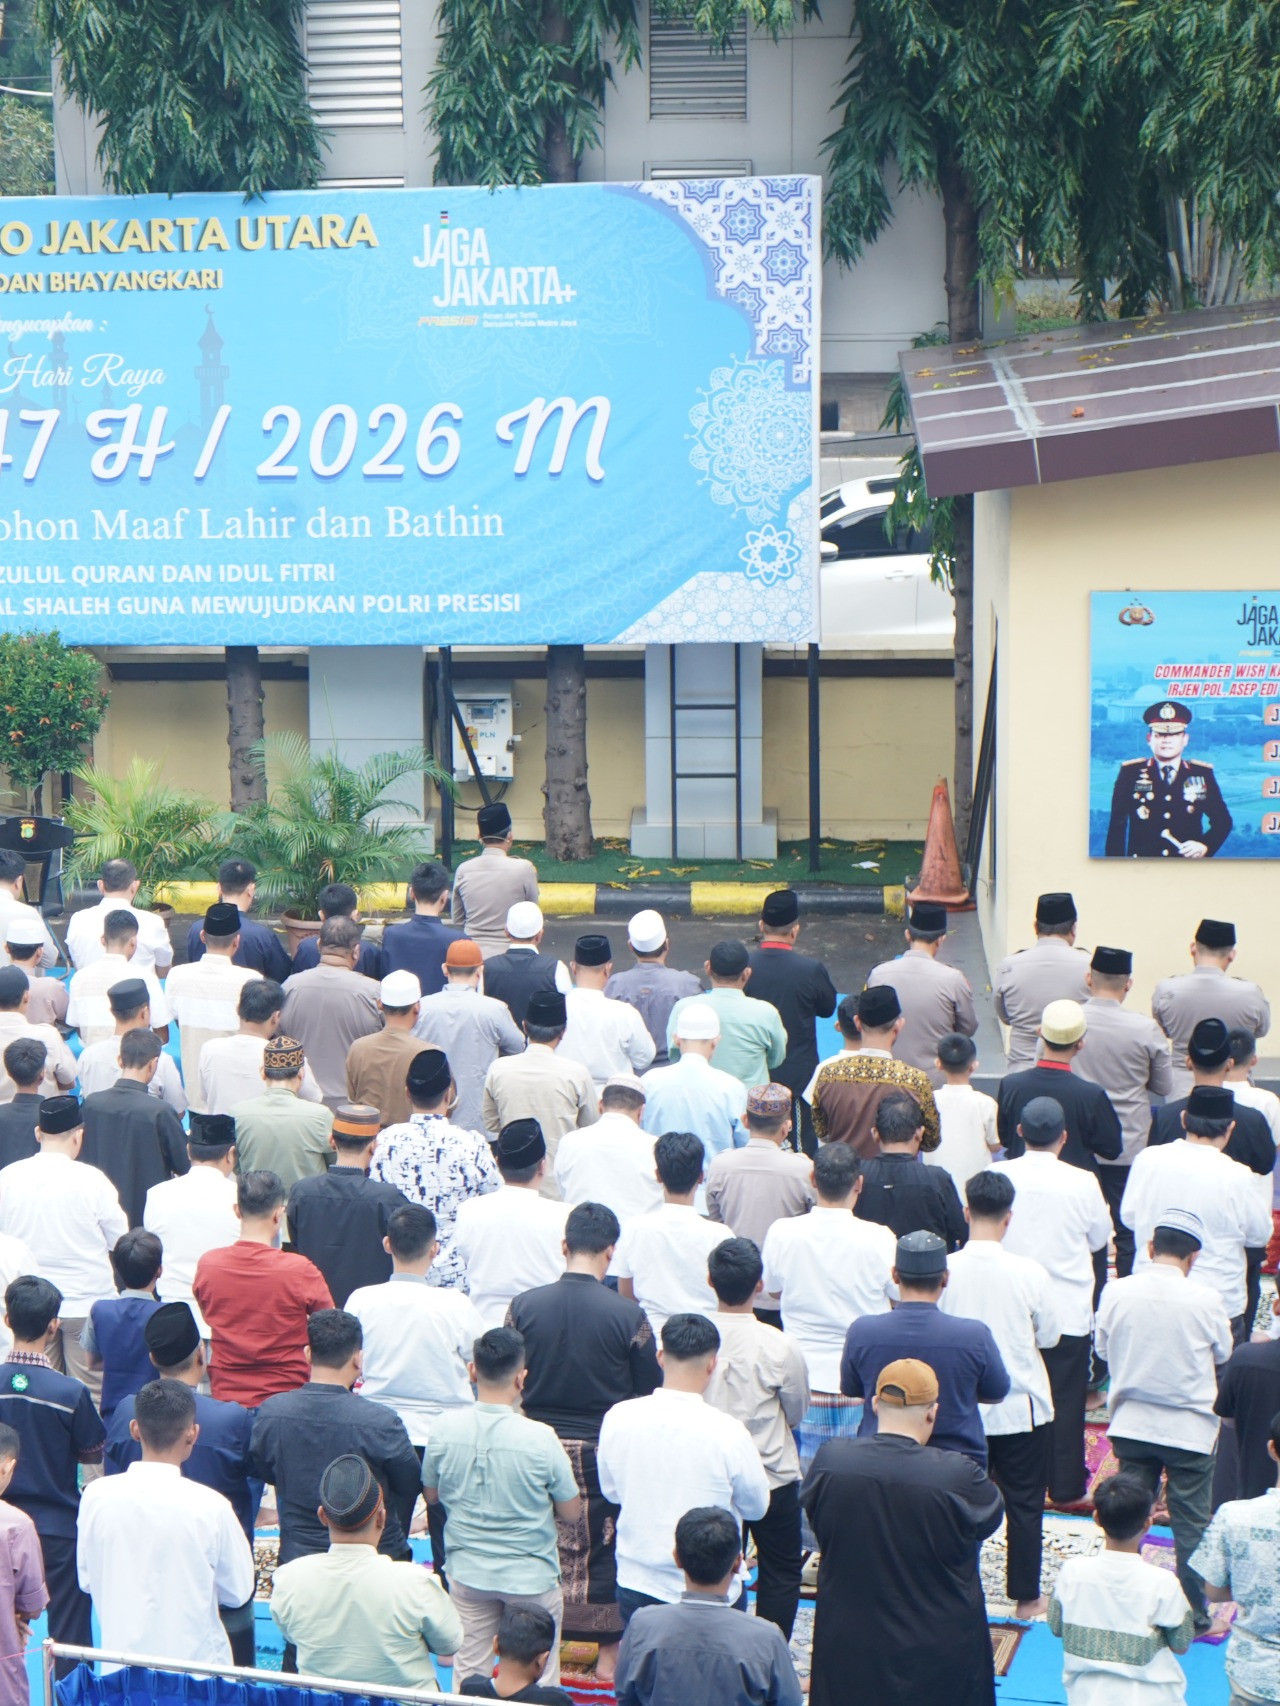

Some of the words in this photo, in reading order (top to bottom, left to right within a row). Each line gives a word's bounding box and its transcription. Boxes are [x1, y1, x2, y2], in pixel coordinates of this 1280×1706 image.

[41, 217, 230, 255] JAKARTA
[237, 213, 379, 251] UTARA
[412, 223, 491, 268] JAGA
[50, 269, 224, 293] BHAYANGKARI
[417, 315, 478, 327] PRESISI
[81, 353, 167, 397] Raya
[85, 404, 176, 481] H
[193, 404, 232, 479] /
[256, 401, 464, 478] 2026
[496, 395, 612, 481] M
[91, 508, 190, 541] Maaf
[198, 507, 296, 540] Lahir
[306, 506, 373, 538] dan
[384, 504, 505, 538] Bathin
[71, 565, 155, 587] QURAN
[162, 565, 213, 583] DAN
[221, 564, 273, 583] IDUL
[280, 564, 335, 582] FITRI
[23, 597, 111, 615] SHALEH
[119, 596, 184, 615] GUNA
[191, 595, 355, 619] MEWUJUDKAN
[363, 594, 430, 613] POLRI
[438, 594, 520, 612] PRESISI
[1237, 603, 1279, 625] JAGA
[1247, 626, 1280, 646] JAK
[1155, 665, 1232, 678] COMMANDER
[1236, 665, 1266, 677] WISH
[1168, 683, 1200, 696] IRJEN
[1202, 683, 1226, 696] POL.
[1229, 683, 1258, 695] ASEP
[1260, 683, 1278, 695] EDI
